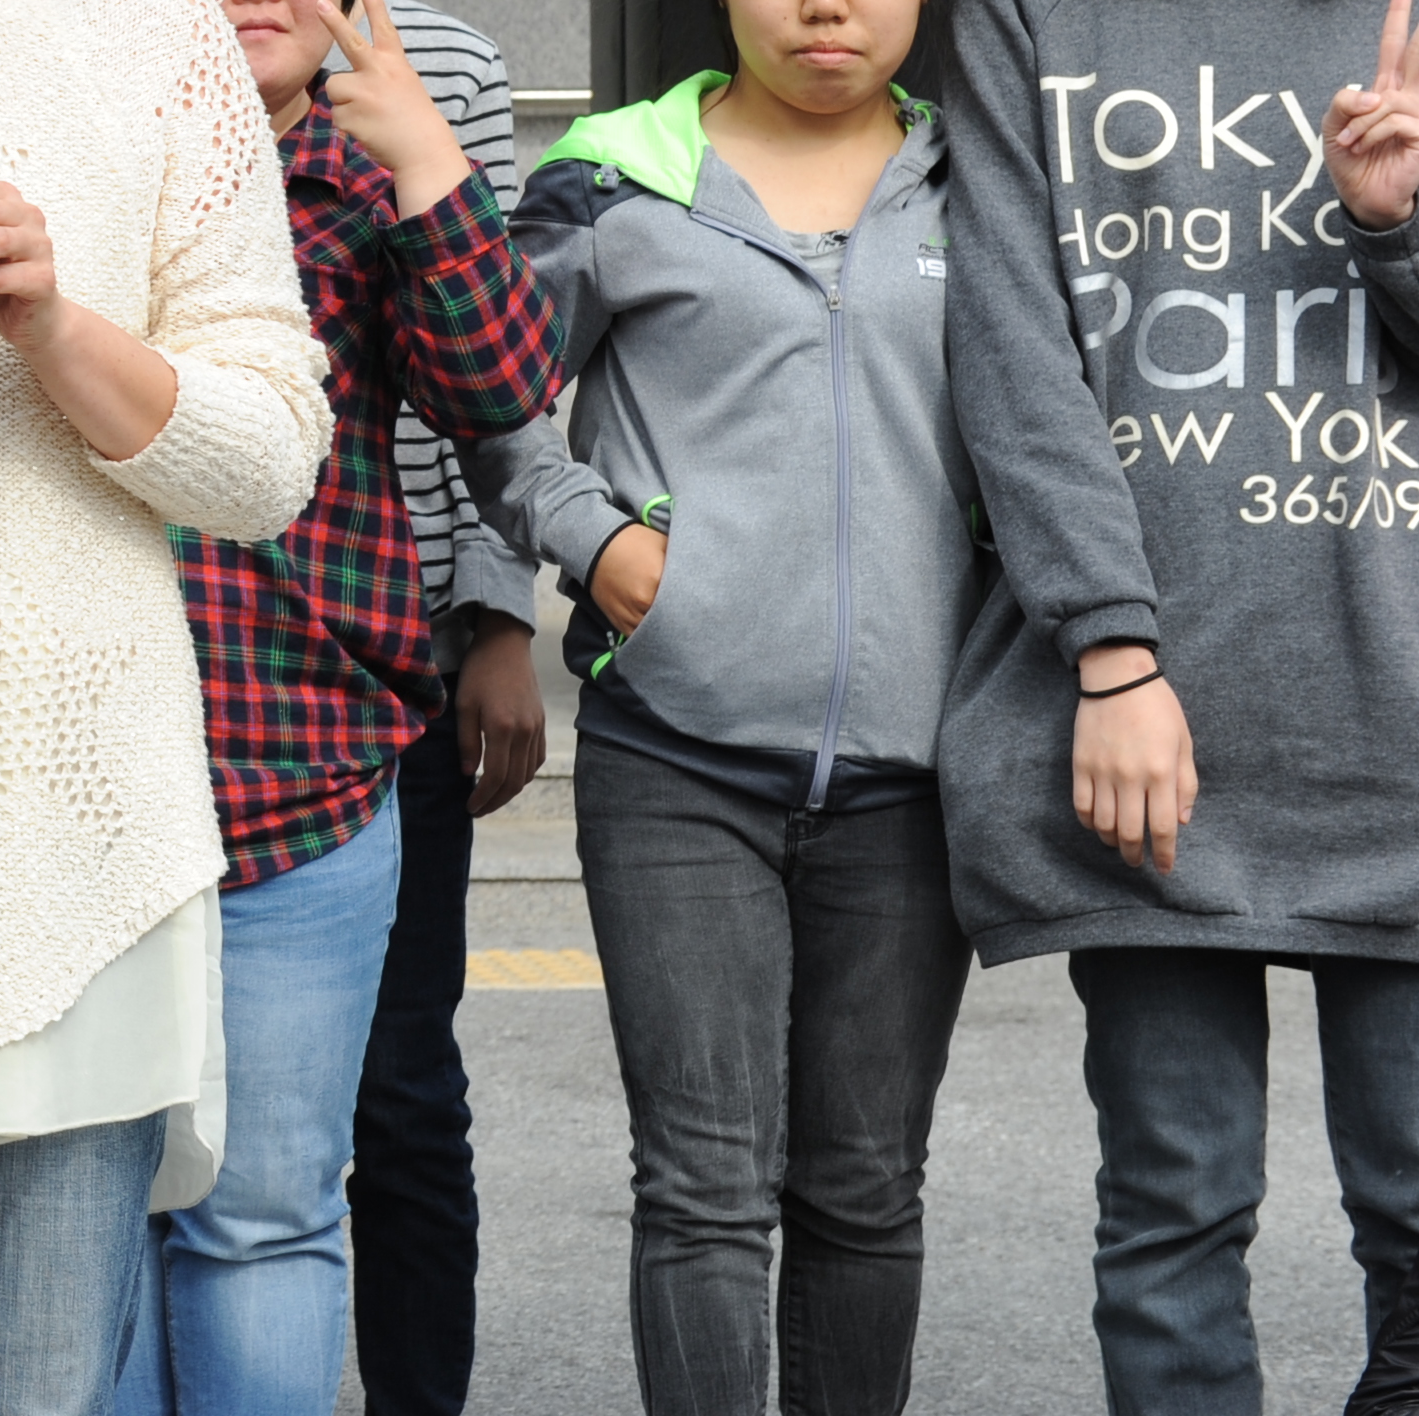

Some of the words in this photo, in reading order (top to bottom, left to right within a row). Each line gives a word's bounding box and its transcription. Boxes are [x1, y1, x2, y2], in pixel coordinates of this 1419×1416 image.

[1040, 65, 1362, 189] Toky
[1059, 206, 1230, 271] Hong
[1261, 189, 1347, 251] Ko
[1109, 410, 1234, 467] ew
[1265, 392, 1419, 468] Yok
